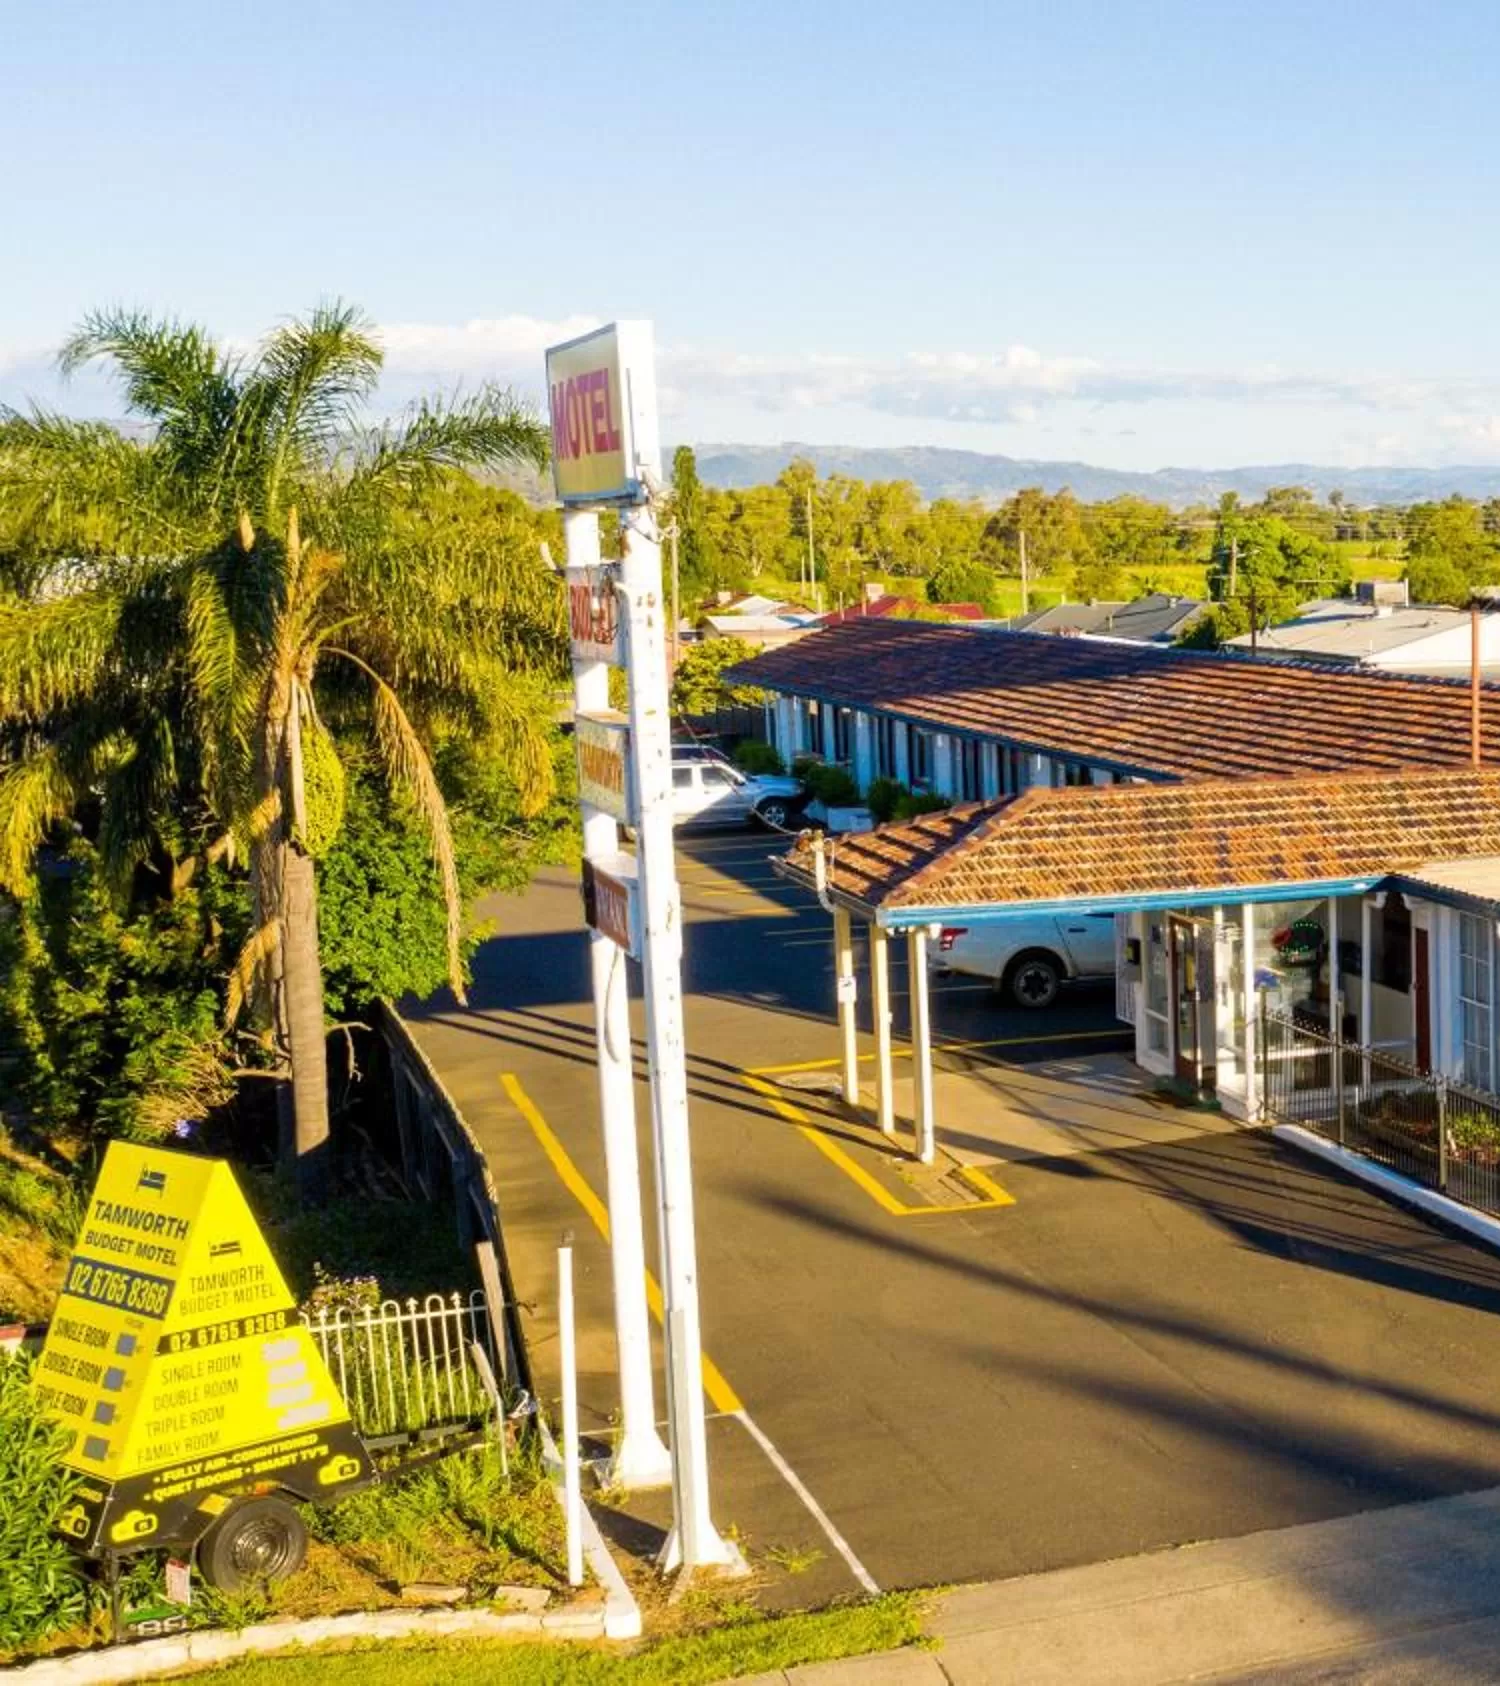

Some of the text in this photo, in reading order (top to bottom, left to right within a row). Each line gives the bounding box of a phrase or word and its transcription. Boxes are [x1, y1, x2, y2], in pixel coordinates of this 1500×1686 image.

[552, 367, 621, 460] MOTEL
[94, 1200, 190, 1240] TAMWORTH
[84, 1230, 177, 1266] BUDGET MOTEL
[69, 1262, 168, 1313] 02 6765 8368
[190, 1264, 265, 1294] TAMWORTH
[180, 1283, 276, 1316] BUDGET MOTEL
[54, 1317, 110, 1348] SINGLE ROOM
[170, 1312, 285, 1351] 02 6765 8368
[76, 1359, 102, 1384] ROOM
[161, 1353, 242, 1386] SINGLE ROOM
[62, 1392, 88, 1416] ROOM
[153, 1378, 239, 1412] DOUBLE ROOM
[145, 1405, 225, 1438] TRIPLE ROOM
[137, 1431, 221, 1466] FAMILY ROOM
[152, 1481, 193, 1502] QUIET
[195, 1467, 244, 1489] ROOMS
[252, 1453, 298, 1474] SMART
[162, 1462, 202, 1484] FULLY
